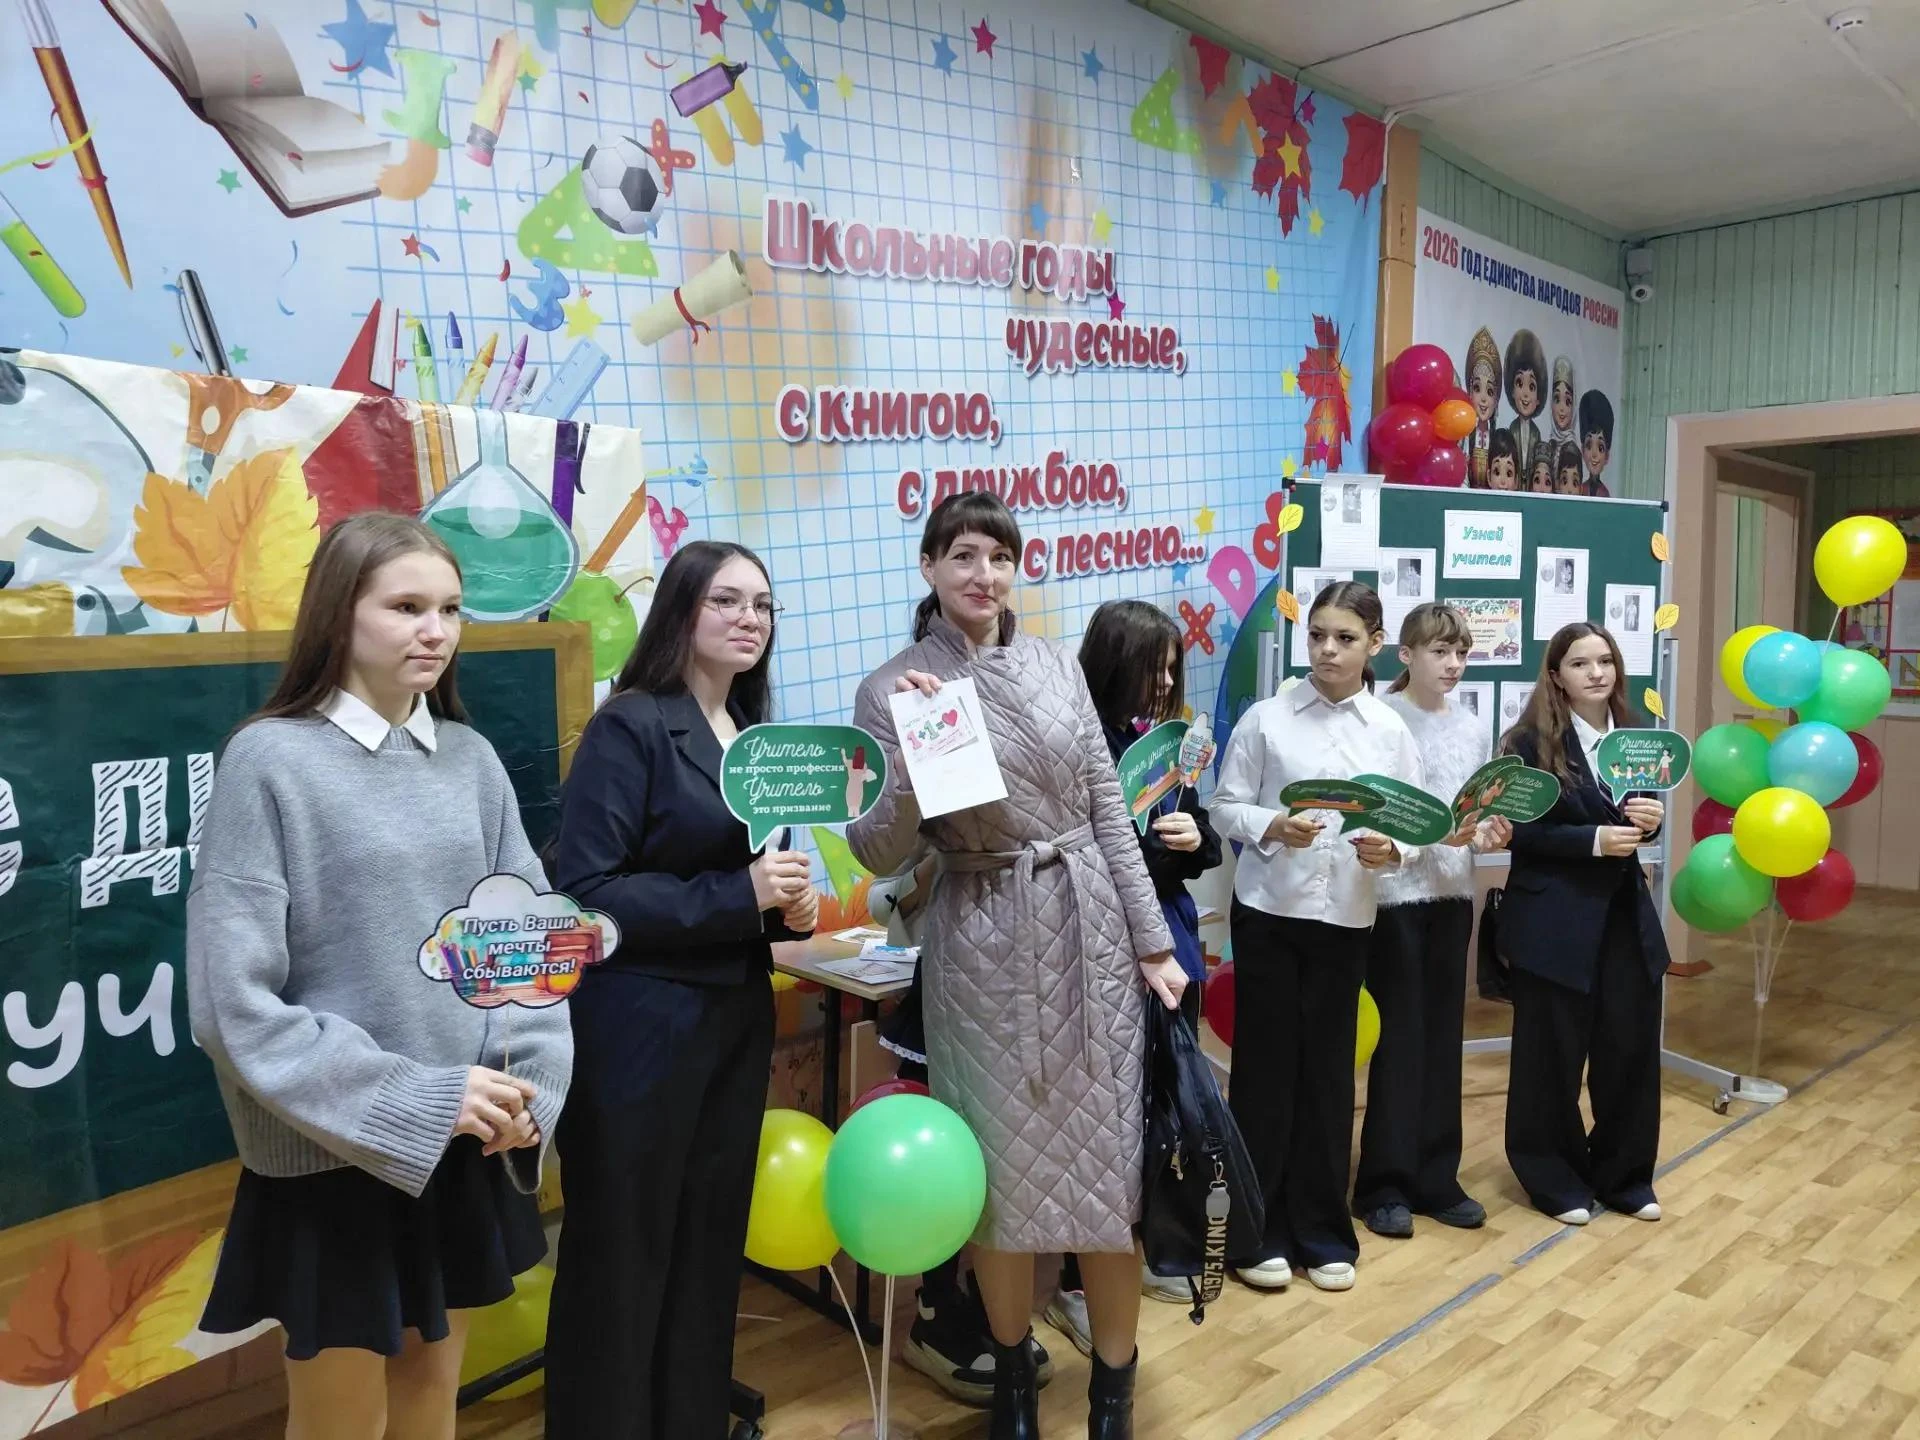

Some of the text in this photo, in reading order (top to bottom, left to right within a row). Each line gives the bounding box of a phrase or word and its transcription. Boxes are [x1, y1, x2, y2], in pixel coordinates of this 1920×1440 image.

[767, 198, 1115, 298] Школьные годы
[1423, 225, 1619, 329] 2026 ГОД ЕДИНСТВА НАРОДОВ РОССИИ
[1006, 317, 1187, 374] чудесные,
[818, 389, 1000, 443] книгою,
[1462, 526, 1504, 541] Узнай
[1057, 524, 1205, 572] песнею...
[1452, 553, 1513, 568] учителя
[744, 736, 826, 765] Учитель
[1617, 735, 1664, 752] Учителя
[728, 763, 845, 776] не просто профессия
[743, 776, 824, 806] Учитель
[752, 804, 832, 816] это призвание
[463, 914, 577, 938] Пусть Ваши
[488, 940, 552, 955] мечты
[462, 958, 577, 980] сбываются!
